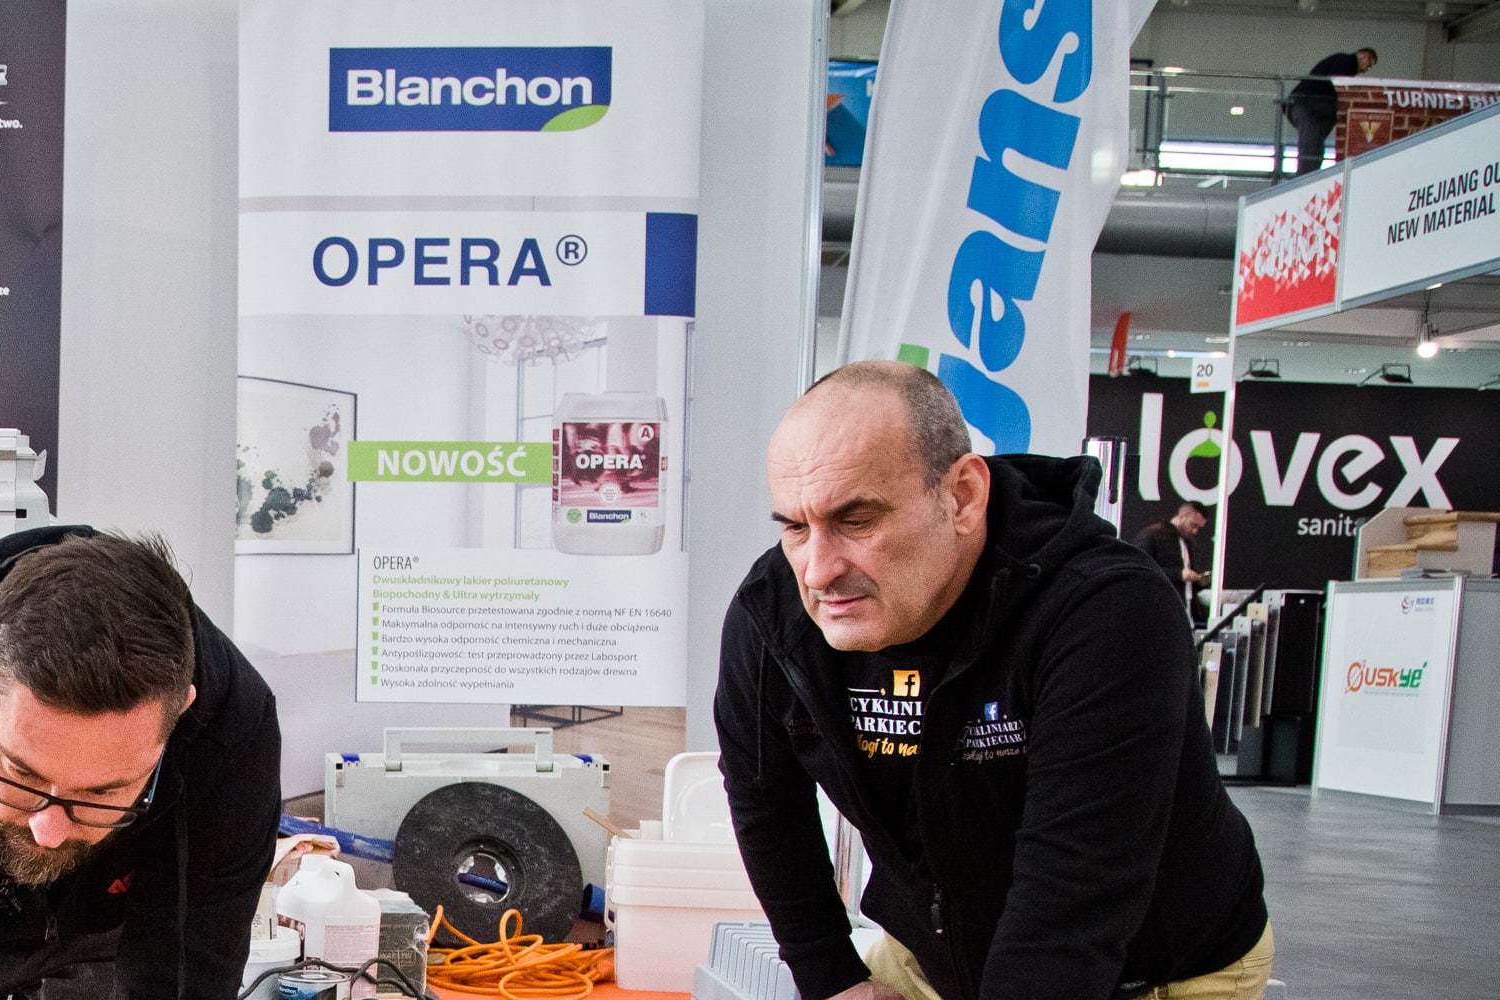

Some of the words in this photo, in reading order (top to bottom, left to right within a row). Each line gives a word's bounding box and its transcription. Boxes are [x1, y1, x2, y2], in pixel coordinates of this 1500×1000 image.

[347, 67, 593, 107] Blanchon
[1408, 169, 1478, 213] ZHEJIANG
[1387, 215, 1420, 245] NEW
[1423, 192, 1496, 235] MATERIAL
[1196, 363, 1214, 378] 20
[641, 426, 651, 439] A
[1138, 392, 1460, 510] lovex
[377, 448, 527, 478] NOWOŚĆ
[589, 510, 630, 521] Blanchon
[372, 574, 461, 587] Dwuskładnikowy
[463, 575, 492, 587] lakier
[493, 576, 569, 588] poliuretanowy
[372, 589, 441, 601] Biopochodny
[442, 590, 450, 600] &
[453, 590, 478, 600] Ultra
[480, 590, 540, 602] wytrzymały
[382, 604, 420, 615] Formuła
[421, 605, 466, 615] Biosource
[467, 606, 535, 617] przetestowana
[536, 606, 573, 618] zgodnie
[575, 608, 581, 616] z
[582, 608, 612, 619] normą
[614, 608, 628, 617] NF
[629, 608, 642, 617] EN
[645, 608, 672, 618] 16640
[382, 619, 439, 631] Maksymalna
[440, 619, 490, 631] odporność
[491, 621, 503, 630] na
[505, 621, 557, 632] intensywny
[558, 621, 580, 632] ruch
[585, 622, 608, 633] duże
[610, 622, 659, 634] obciążenia
[381, 634, 413, 644] Bardzo
[415, 635, 449, 646] wysoka
[450, 635, 500, 646] odporność
[501, 636, 550, 646] chemiczna
[557, 636, 617, 646] mechaniczna
[467, 650, 485, 660] test
[486, 651, 563, 662] przeprowadzony
[564, 653, 589, 662] przez
[591, 652, 638, 663] Labosport
[380, 678, 415, 689] Wysoka
[417, 678, 458, 688] zdolność
[459, 680, 515, 691] wypełniania
